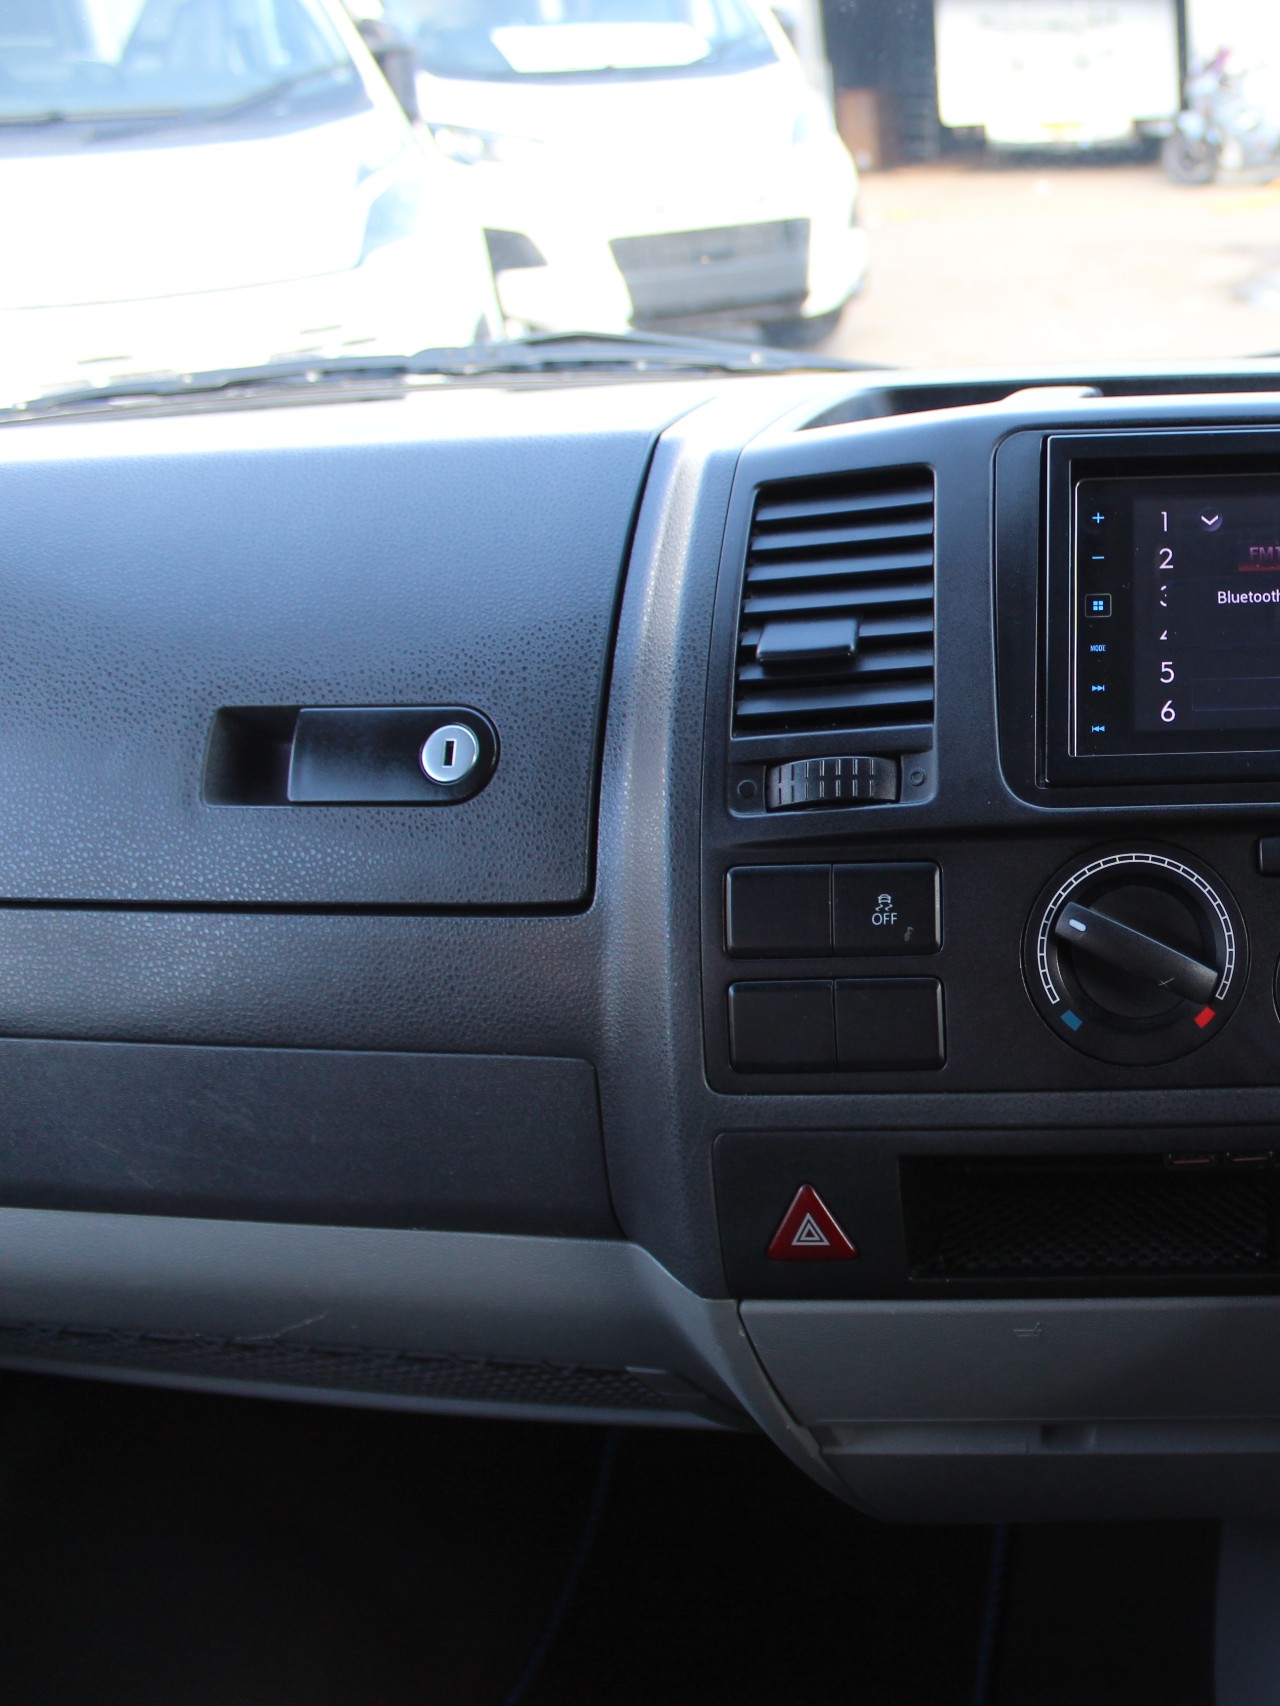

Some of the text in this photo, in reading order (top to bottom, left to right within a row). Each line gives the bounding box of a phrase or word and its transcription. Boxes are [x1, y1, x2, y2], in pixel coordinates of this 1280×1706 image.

[1160, 511, 1169, 532] 1
[1159, 547, 1174, 569] 2
[1160, 661, 1175, 684] 5
[1160, 700, 1176, 722] 6
[871, 912, 898, 926] OFF
